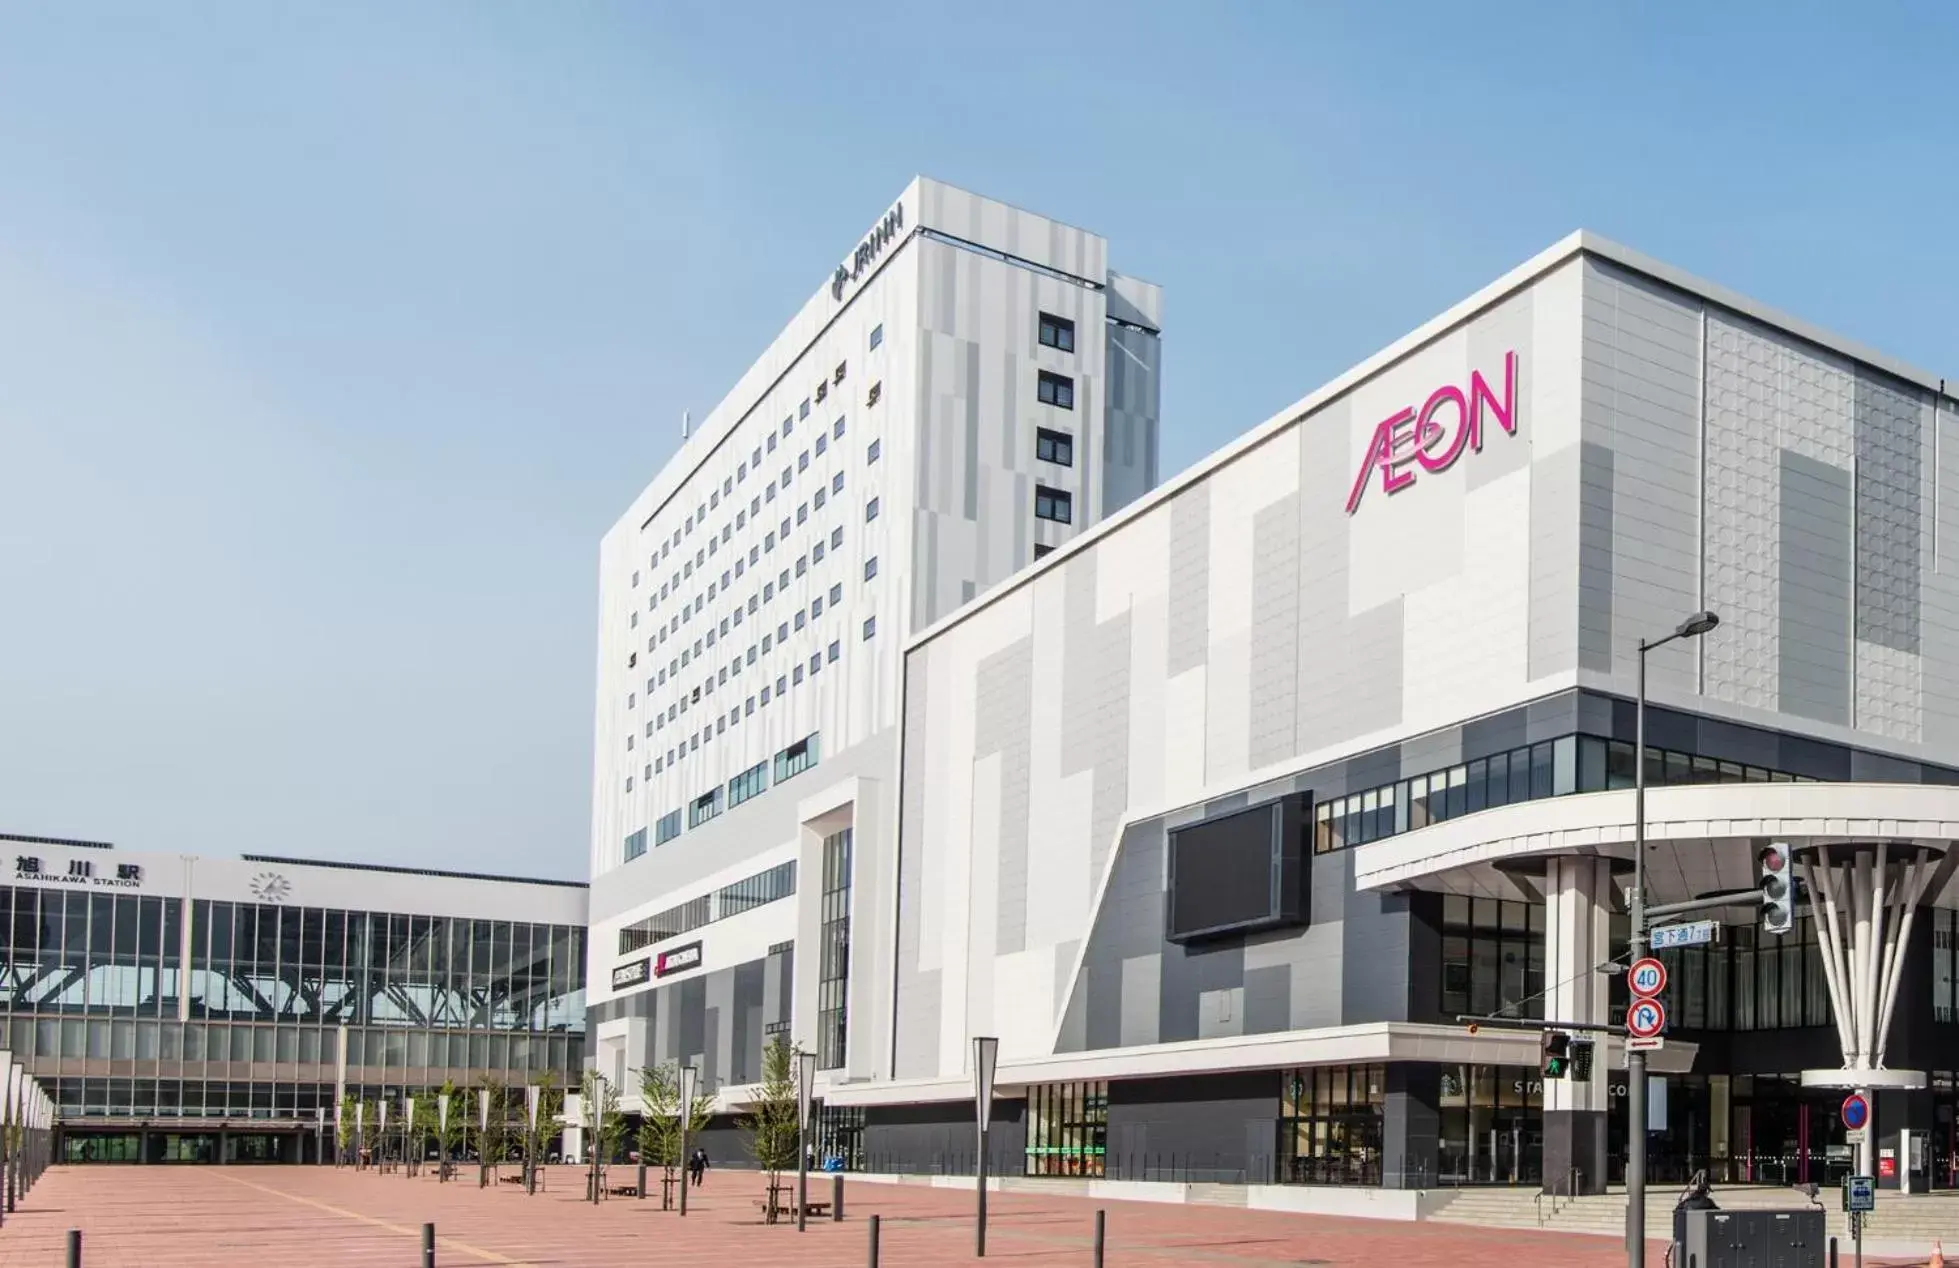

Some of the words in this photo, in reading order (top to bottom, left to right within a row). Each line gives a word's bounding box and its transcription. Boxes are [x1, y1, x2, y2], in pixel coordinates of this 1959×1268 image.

[16, 873, 87, 884] ASAHIKAWA
[93, 878, 140, 888] STATION
[1637, 969, 1657, 986] 40
